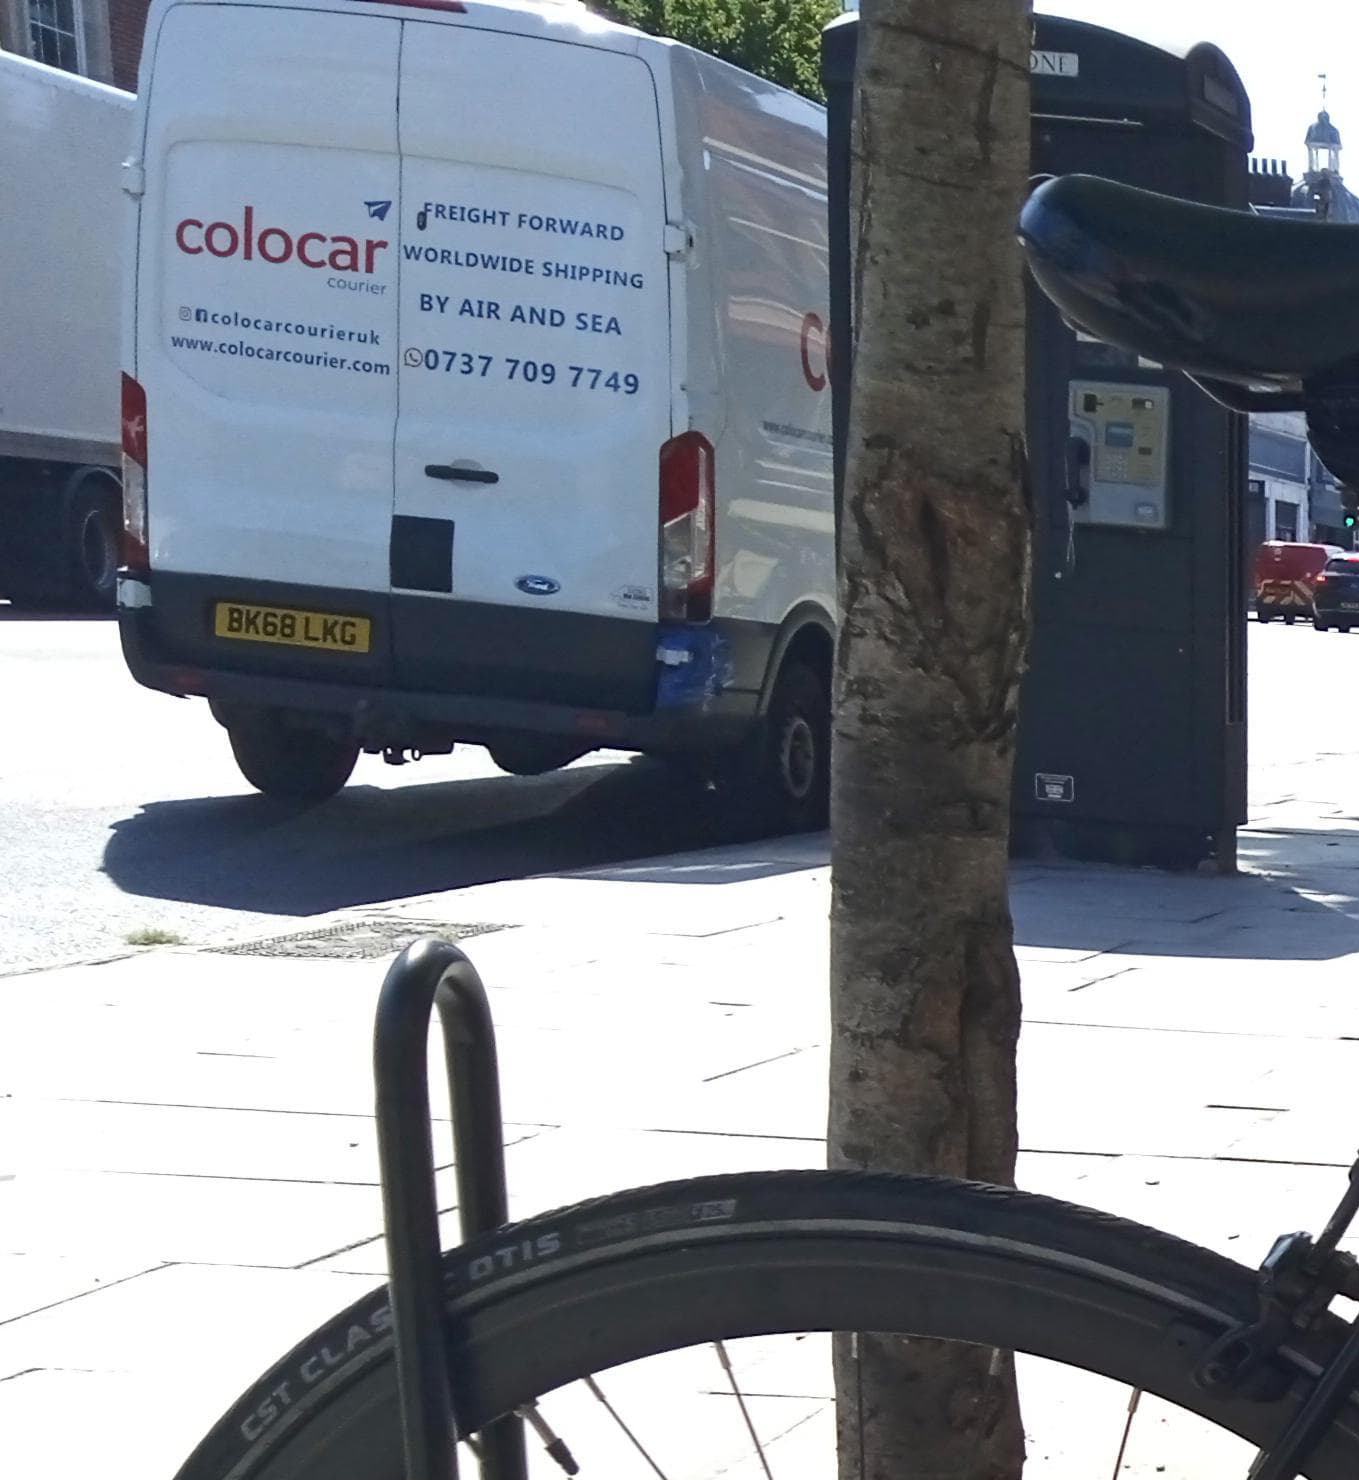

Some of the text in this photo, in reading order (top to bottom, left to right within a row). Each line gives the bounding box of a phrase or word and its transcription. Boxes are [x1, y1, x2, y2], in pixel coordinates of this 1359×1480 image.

[175, 205, 389, 274] colocar
[424, 202, 625, 241] FREIGHT FORWARD
[326, 276, 388, 295] courier
[403, 244, 645, 290] WORLDWIDE SHIPPING
[211, 311, 381, 346] colocarcourieruk
[420, 293, 622, 336] BY AIR AND SEA
[171, 335, 391, 376] www.colocarcourier.com
[424, 349, 640, 396] 0737 709 7749
[226, 607, 357, 646] BK68 LKG
[240, 1378, 293, 1442] CST
